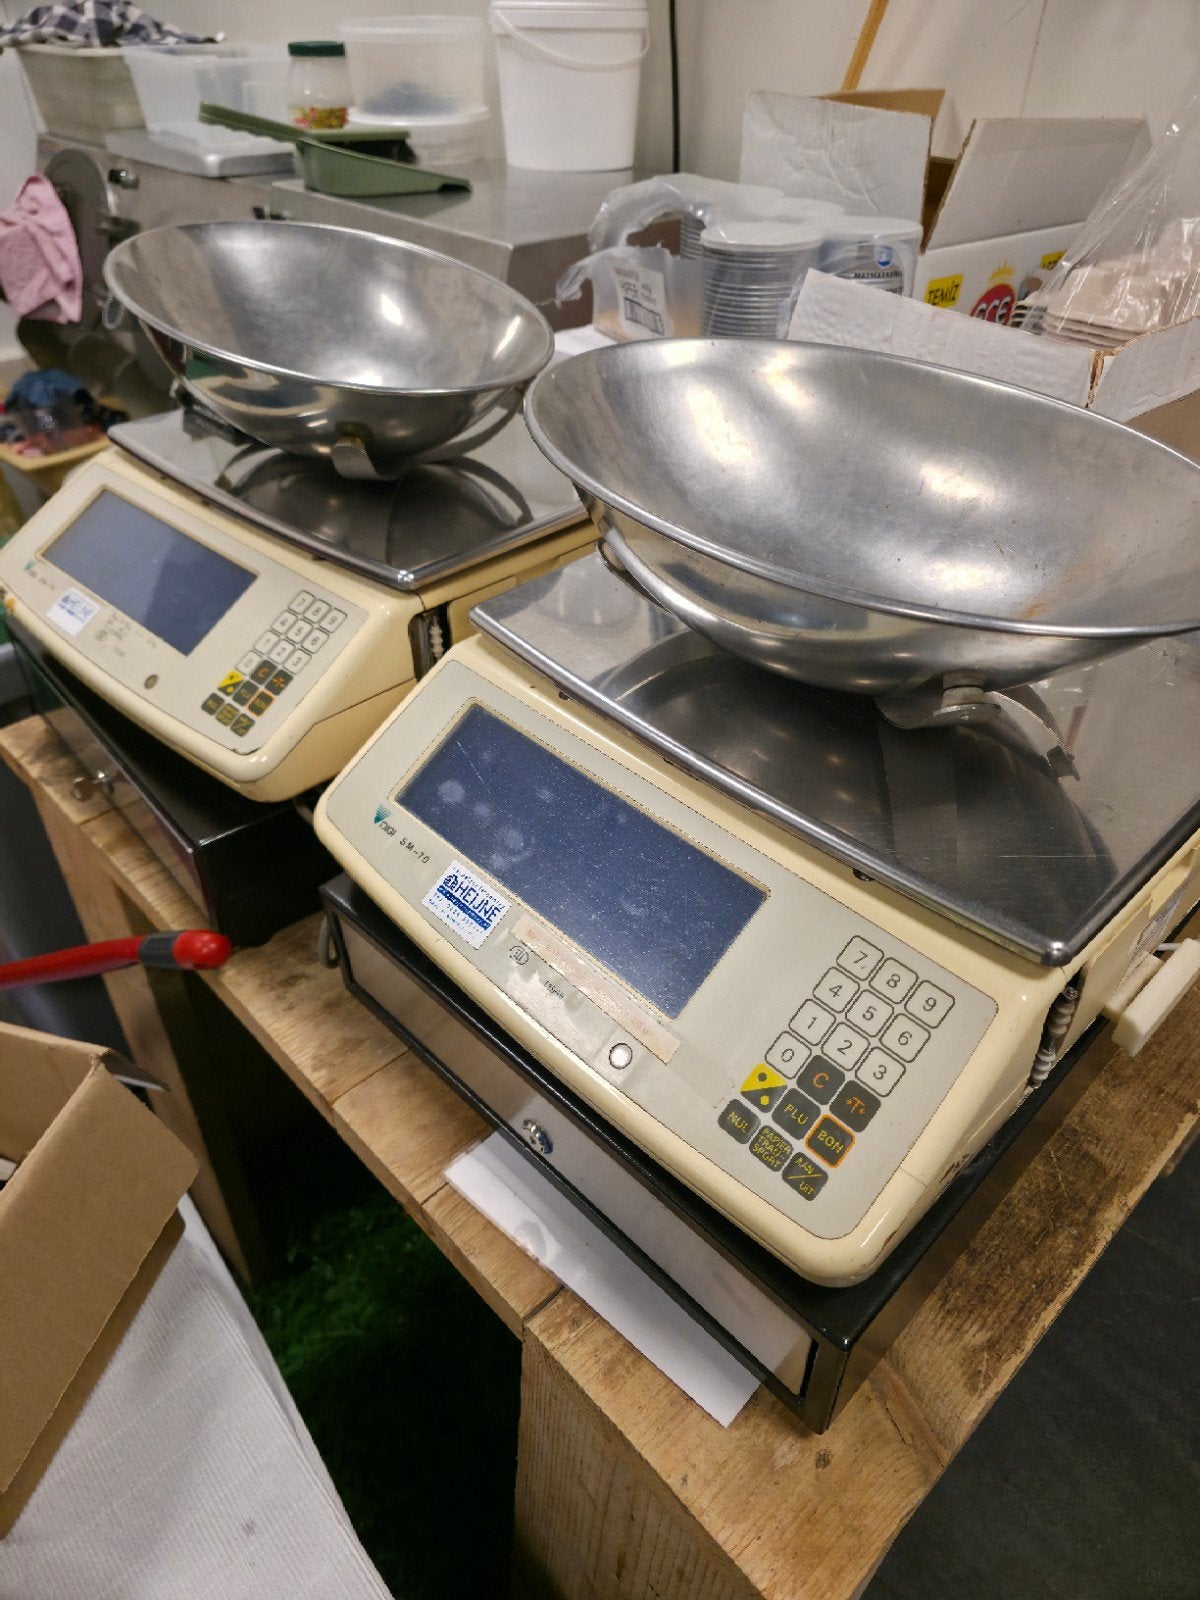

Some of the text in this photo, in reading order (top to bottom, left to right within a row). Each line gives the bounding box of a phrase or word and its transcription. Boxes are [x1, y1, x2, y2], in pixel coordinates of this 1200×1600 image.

[399, 838, 430, 864] SM-70
[454, 881, 502, 923] HEIJNE
[852, 951, 938, 1012] 7 8 9
[829, 984, 913, 1046] 4 5 6
[781, 1048, 795, 1063] 0
[813, 1072, 830, 1088] C
[807, 1016, 887, 1080] 1 2 3
[727, 1110, 749, 1134] NUL
[762, 1127, 792, 1155] PAPIER
[783, 1103, 844, 1154] PLU BON
